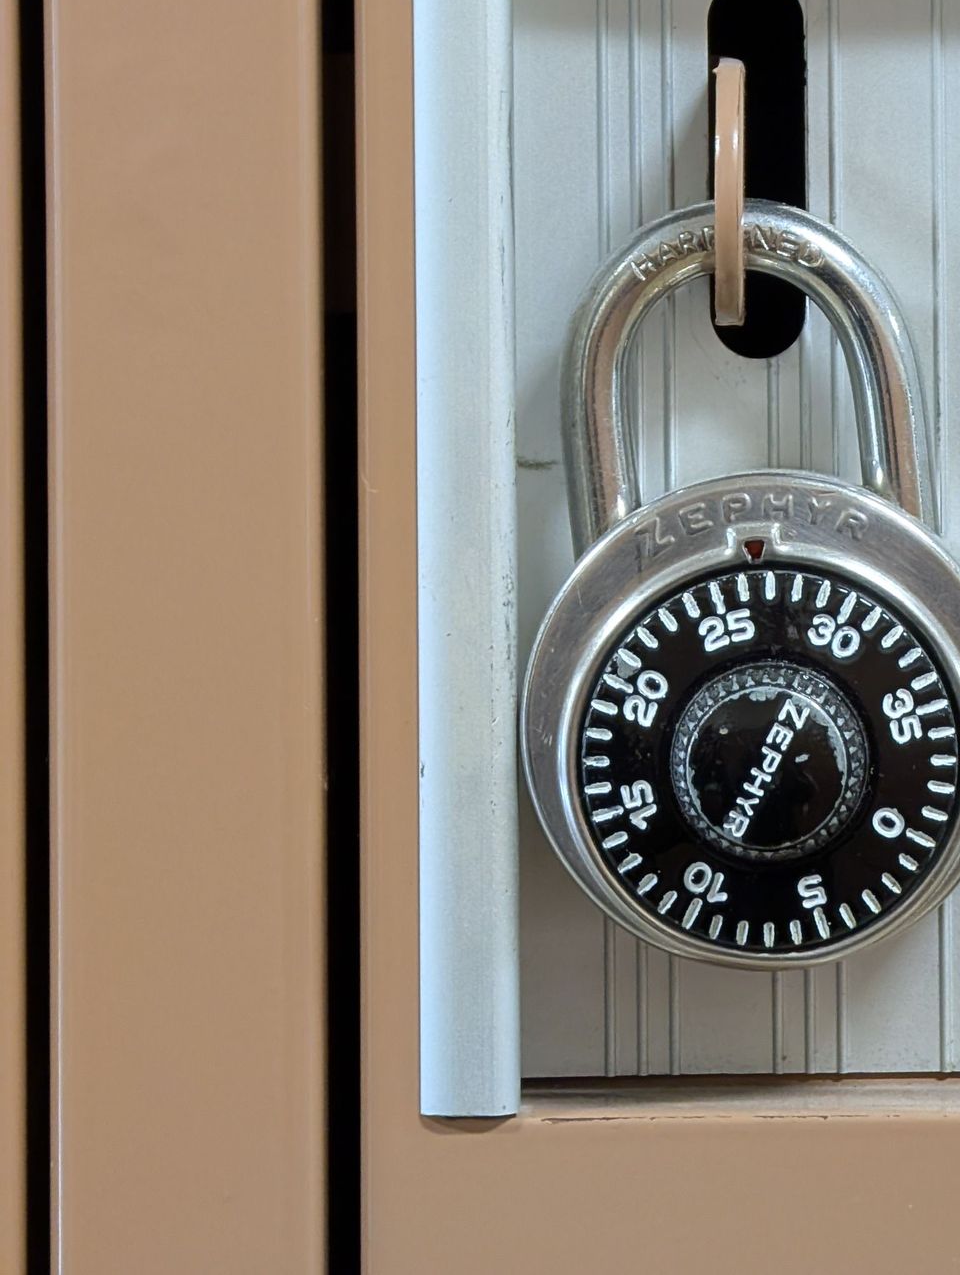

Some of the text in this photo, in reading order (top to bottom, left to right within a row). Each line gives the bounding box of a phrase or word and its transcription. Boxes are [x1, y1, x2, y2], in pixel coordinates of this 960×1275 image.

[635, 491, 872, 557] ZEPHYR
[698, 609, 755, 652] 25
[807, 614, 862, 658] 30
[622, 669, 669, 728] 20
[882, 689, 924, 744] 35
[722, 698, 811, 838] ZEPHYR
[620, 780, 658, 830] 15
[871, 808, 906, 839] 0
[683, 861, 729, 903] 10
[797, 875, 829, 909] 5
